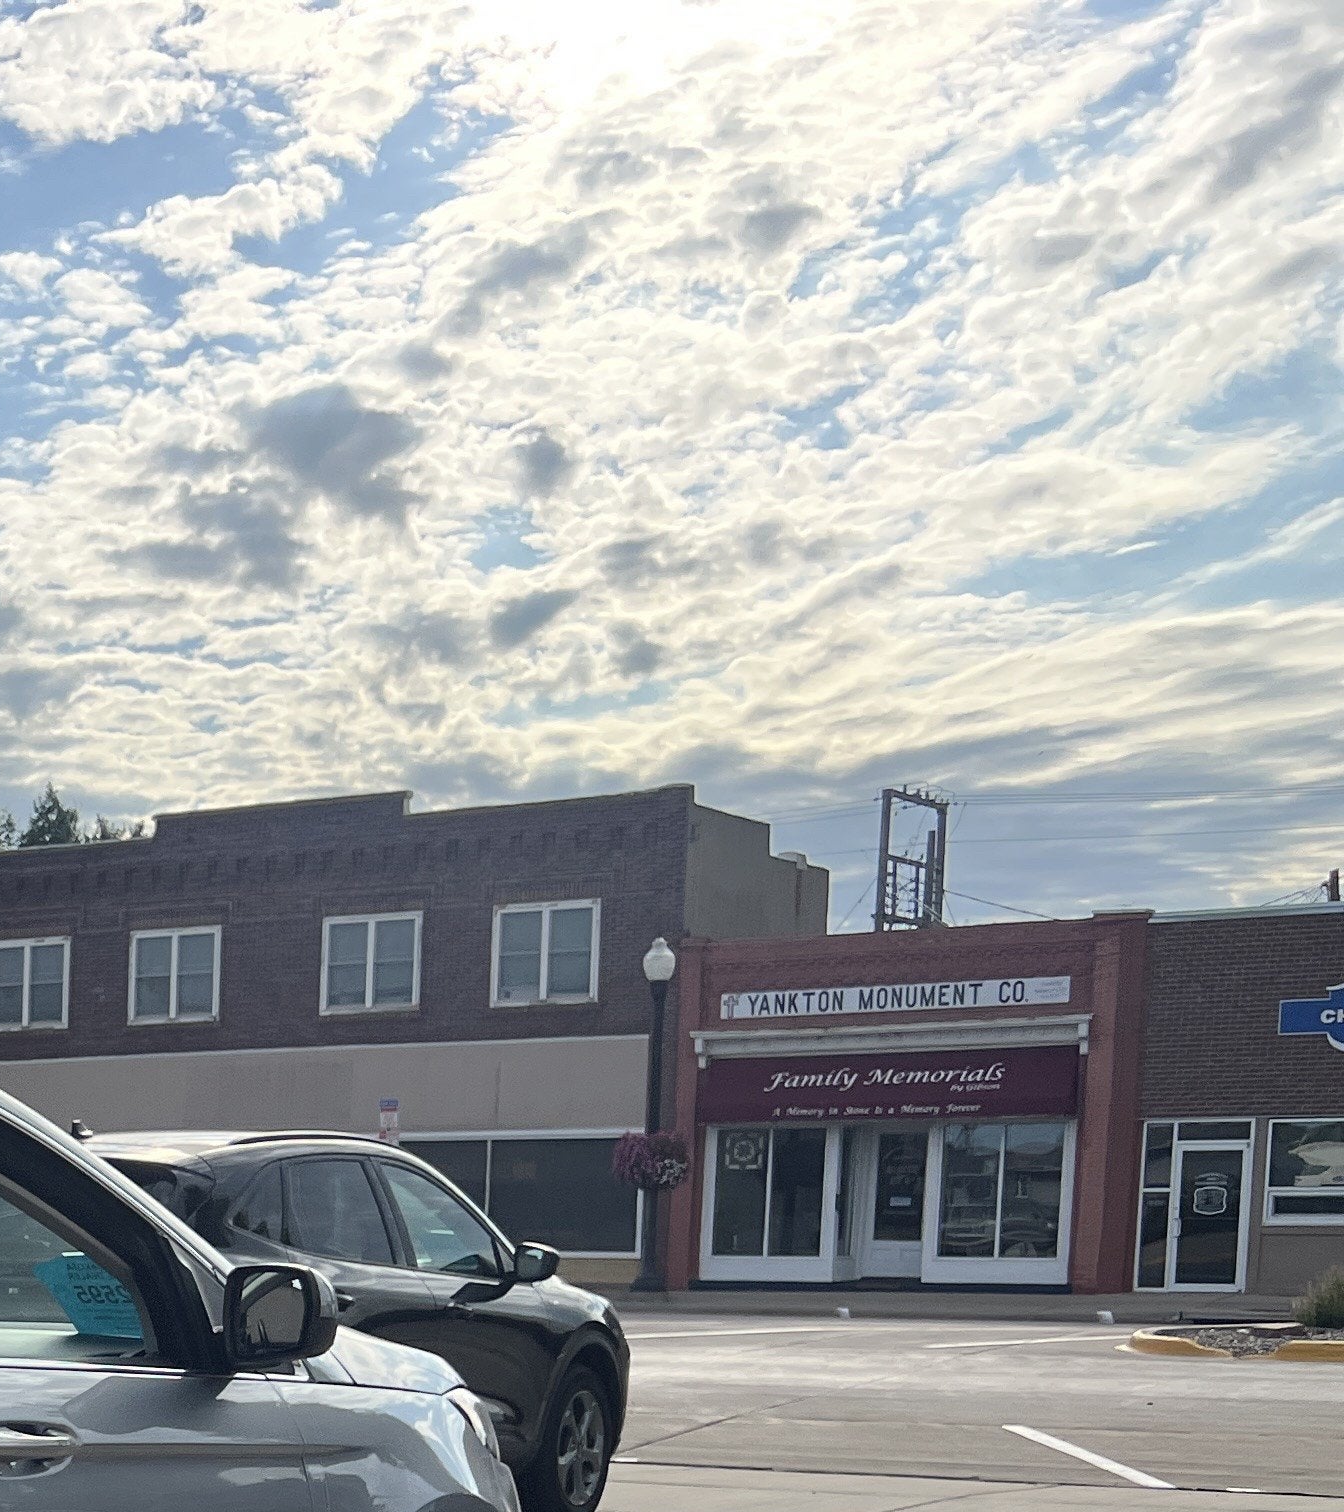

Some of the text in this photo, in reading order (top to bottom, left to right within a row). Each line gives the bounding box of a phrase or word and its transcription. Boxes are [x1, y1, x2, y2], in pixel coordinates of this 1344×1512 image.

[747, 990, 844, 1016] YANKTON
[858, 983, 983, 1011] MONUMENT
[998, 980, 1029, 1003] CO.
[764, 1062, 1006, 1092] Family Memorials
